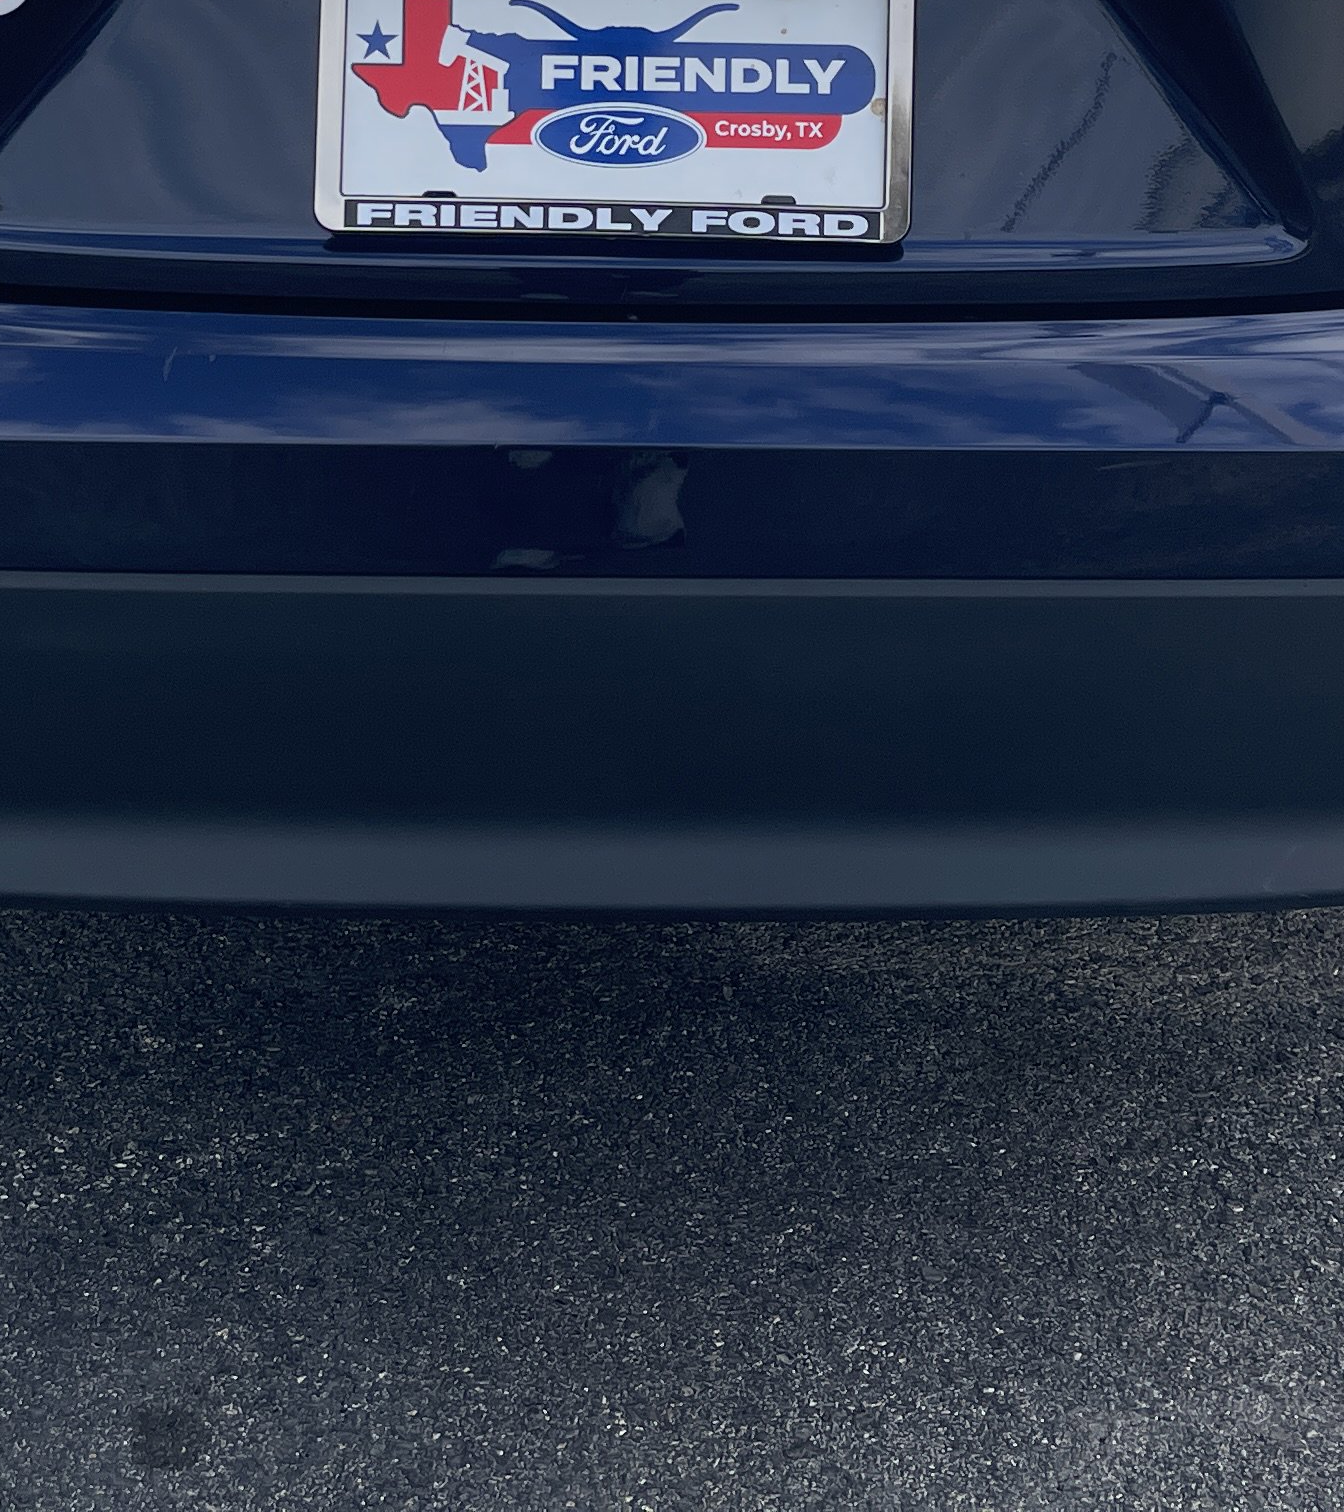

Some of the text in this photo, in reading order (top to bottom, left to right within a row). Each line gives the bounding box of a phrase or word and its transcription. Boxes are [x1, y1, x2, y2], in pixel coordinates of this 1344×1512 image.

[540, 55, 846, 95] FRIENDLY
[569, 114, 666, 156] Ford
[714, 119, 823, 141] Crosby, TX
[356, 202, 870, 238] FRIENDLY FORD
